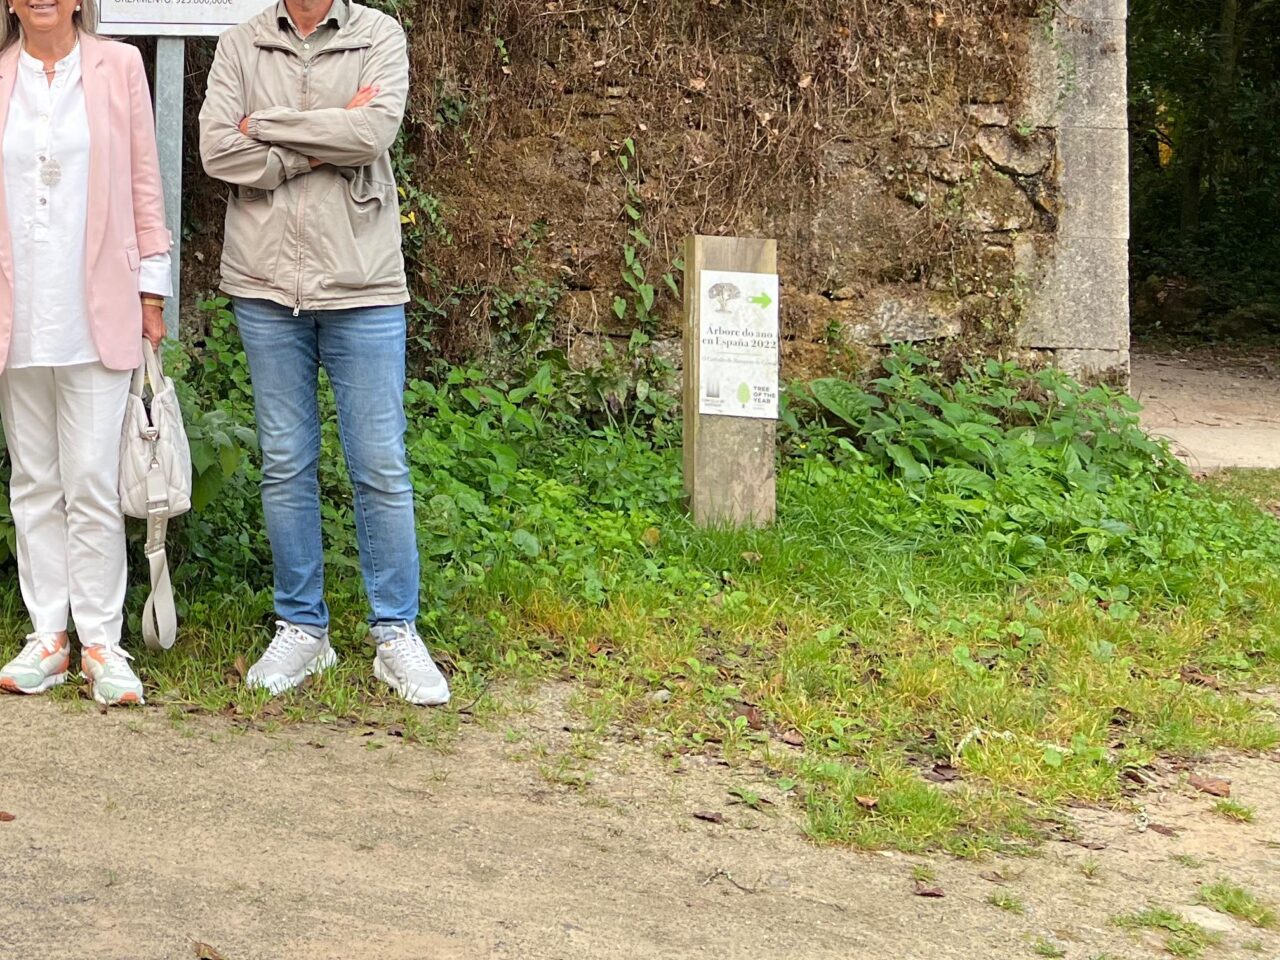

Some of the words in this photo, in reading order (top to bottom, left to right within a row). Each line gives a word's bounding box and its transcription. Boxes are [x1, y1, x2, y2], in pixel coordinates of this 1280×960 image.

[707, 323, 740, 336] Árbore
[742, 328, 754, 337] do
[716, 336, 749, 348] España
[751, 340, 776, 349] 2022
